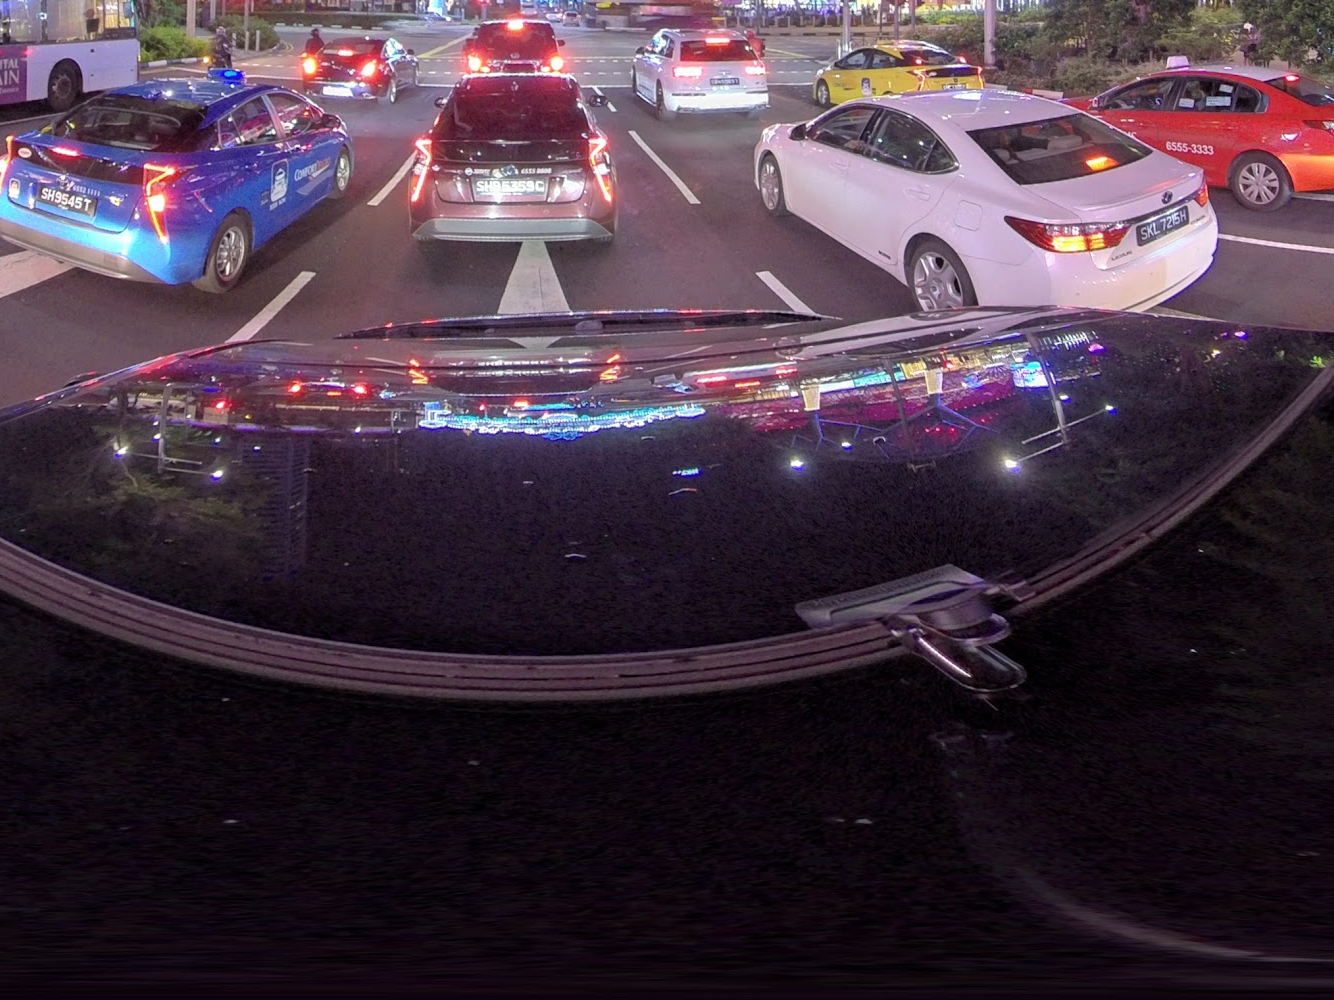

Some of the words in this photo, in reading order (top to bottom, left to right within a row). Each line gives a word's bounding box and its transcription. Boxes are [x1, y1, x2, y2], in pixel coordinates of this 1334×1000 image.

[1166, 141, 1214, 155] 6555-3333
[41, 187, 92, 211] SH9545T
[1140, 224, 1161, 240] SKL
[1161, 209, 1187, 231] 7215H
